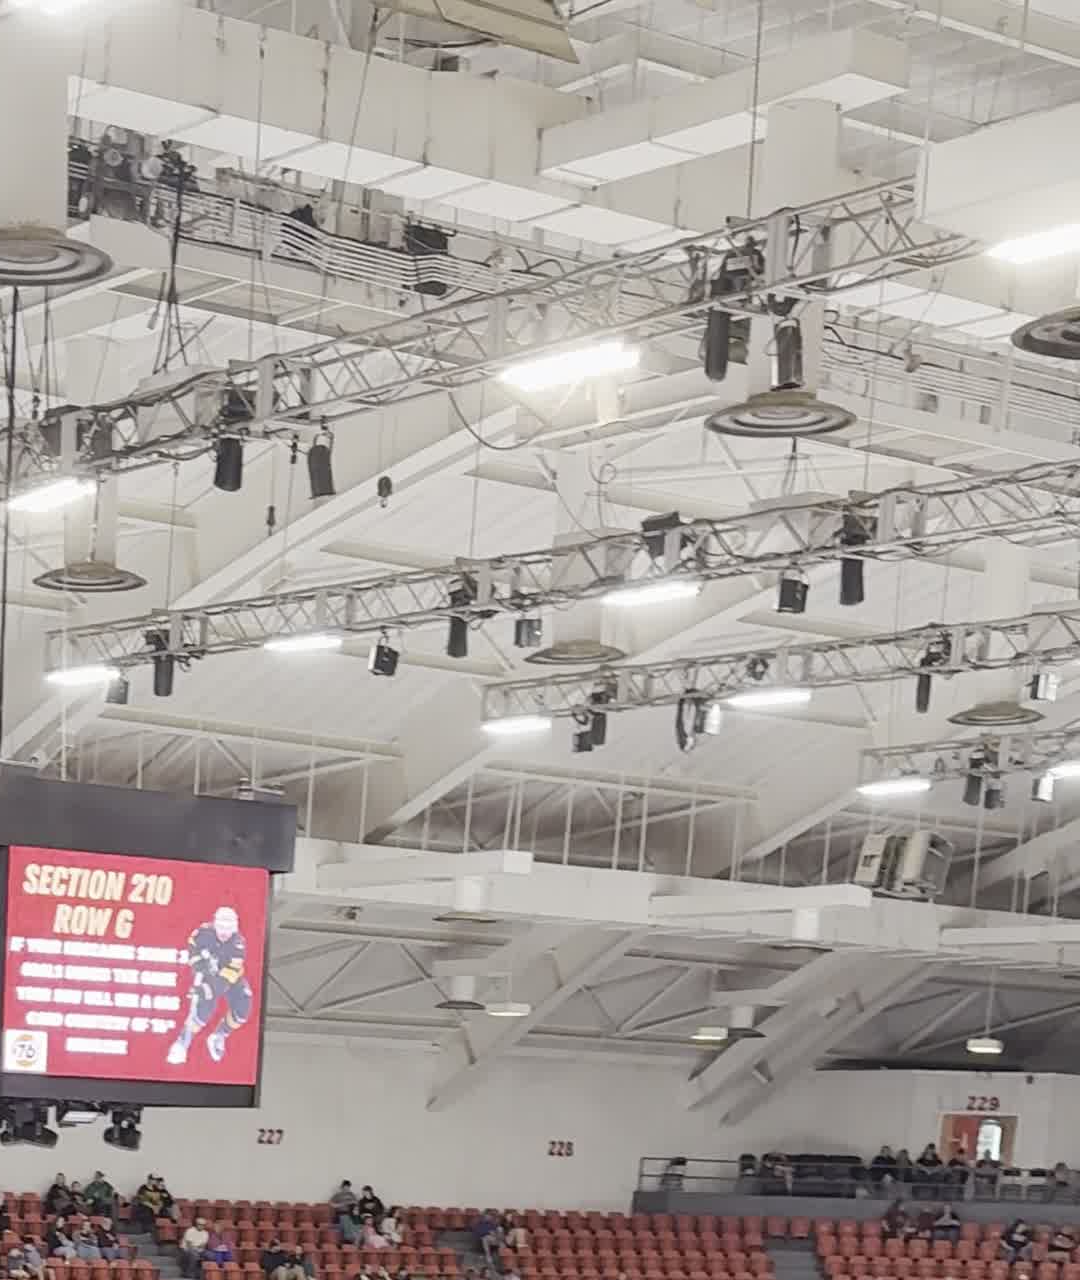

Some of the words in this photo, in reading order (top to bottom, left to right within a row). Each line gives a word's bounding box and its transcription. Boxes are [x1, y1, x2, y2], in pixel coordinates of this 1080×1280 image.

[23, 863, 126, 901] SECTION
[128, 874, 173, 905] 210
[53, 904, 113, 936] ROW
[967, 1096, 1000, 1111] 229
[257, 1128, 284, 1145] 227
[548, 1140, 574, 1157] 228
